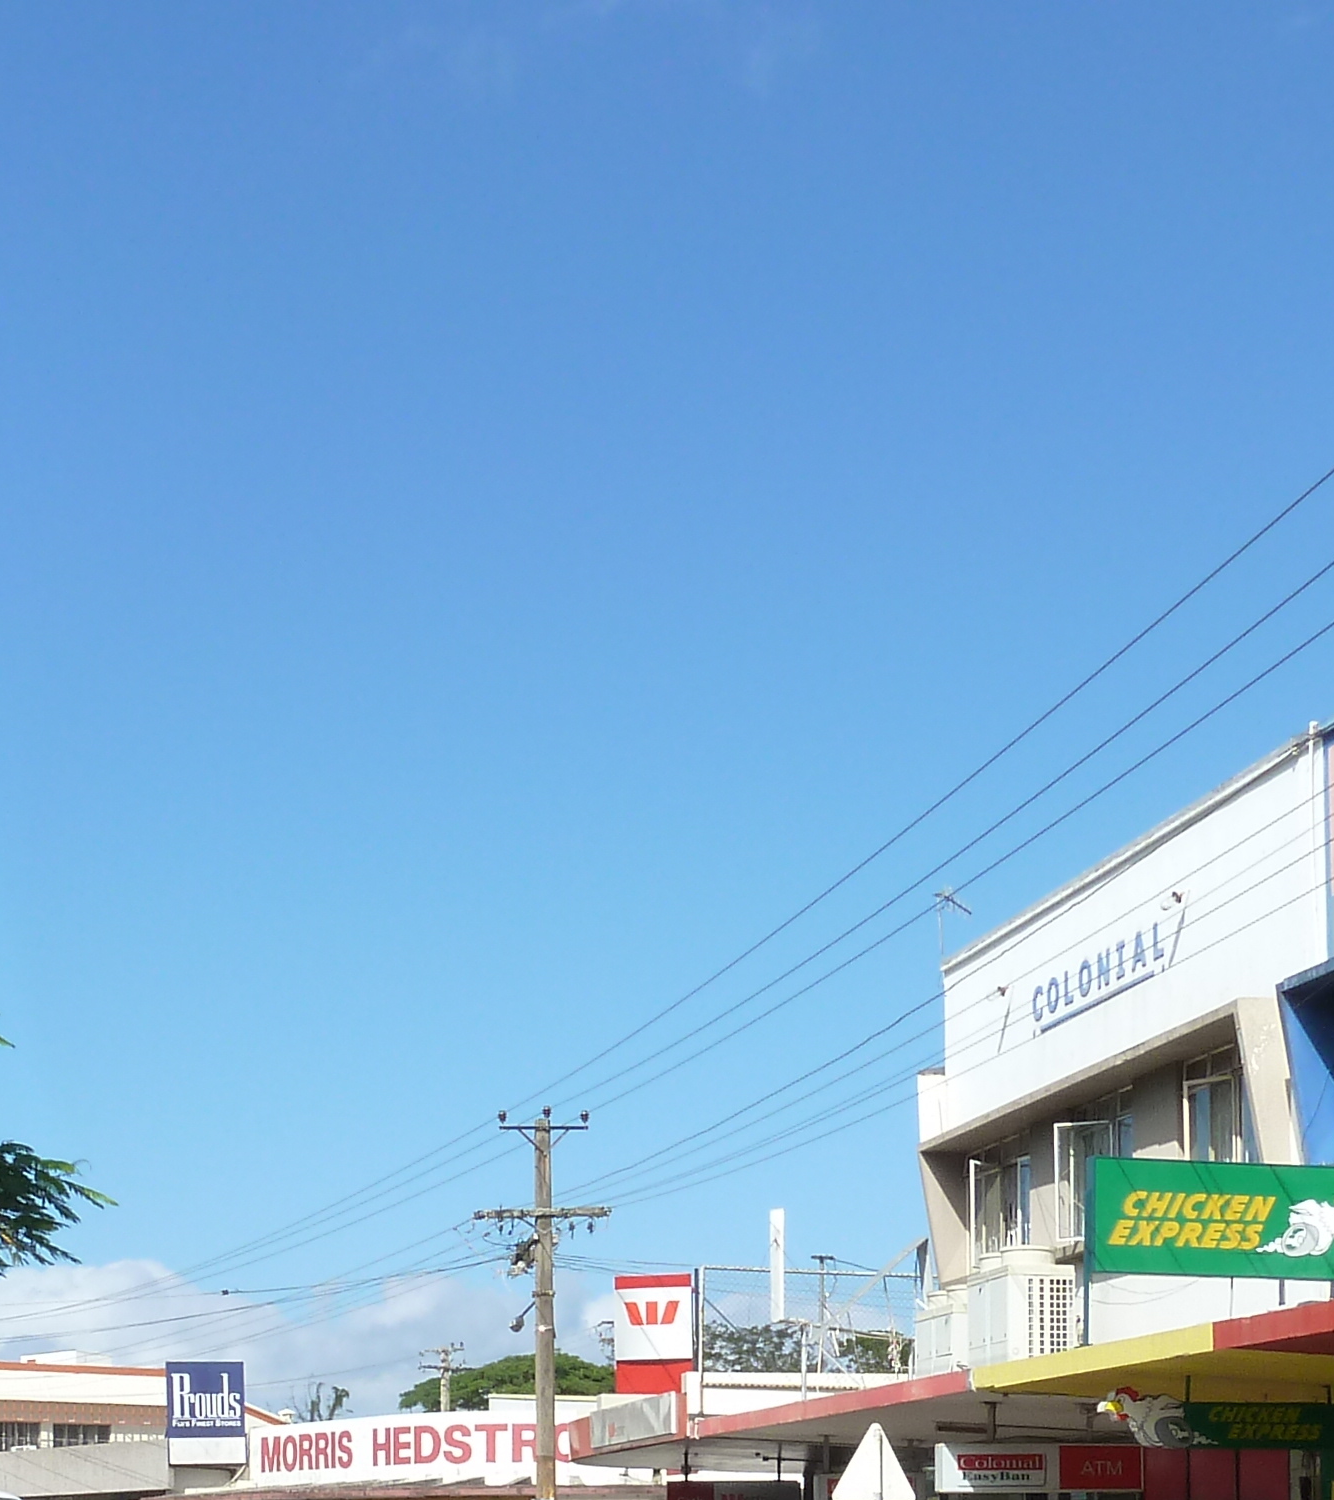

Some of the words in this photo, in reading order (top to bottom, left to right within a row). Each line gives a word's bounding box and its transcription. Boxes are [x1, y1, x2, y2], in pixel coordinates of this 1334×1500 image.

[1032, 922, 1165, 1022] COLONIAL
[1123, 1190, 1276, 1222] CHICKEN
[1107, 1220, 1264, 1250] EXPRESS
[170, 1373, 242, 1419] Prouds
[1208, 1406, 1302, 1423] CHICKEN
[1228, 1424, 1322, 1440] EXPRESS
[260, 1430, 353, 1473] MORRIS
[959, 1457, 1041, 1470] Colonial
[1081, 1461, 1122, 1476] ATM
